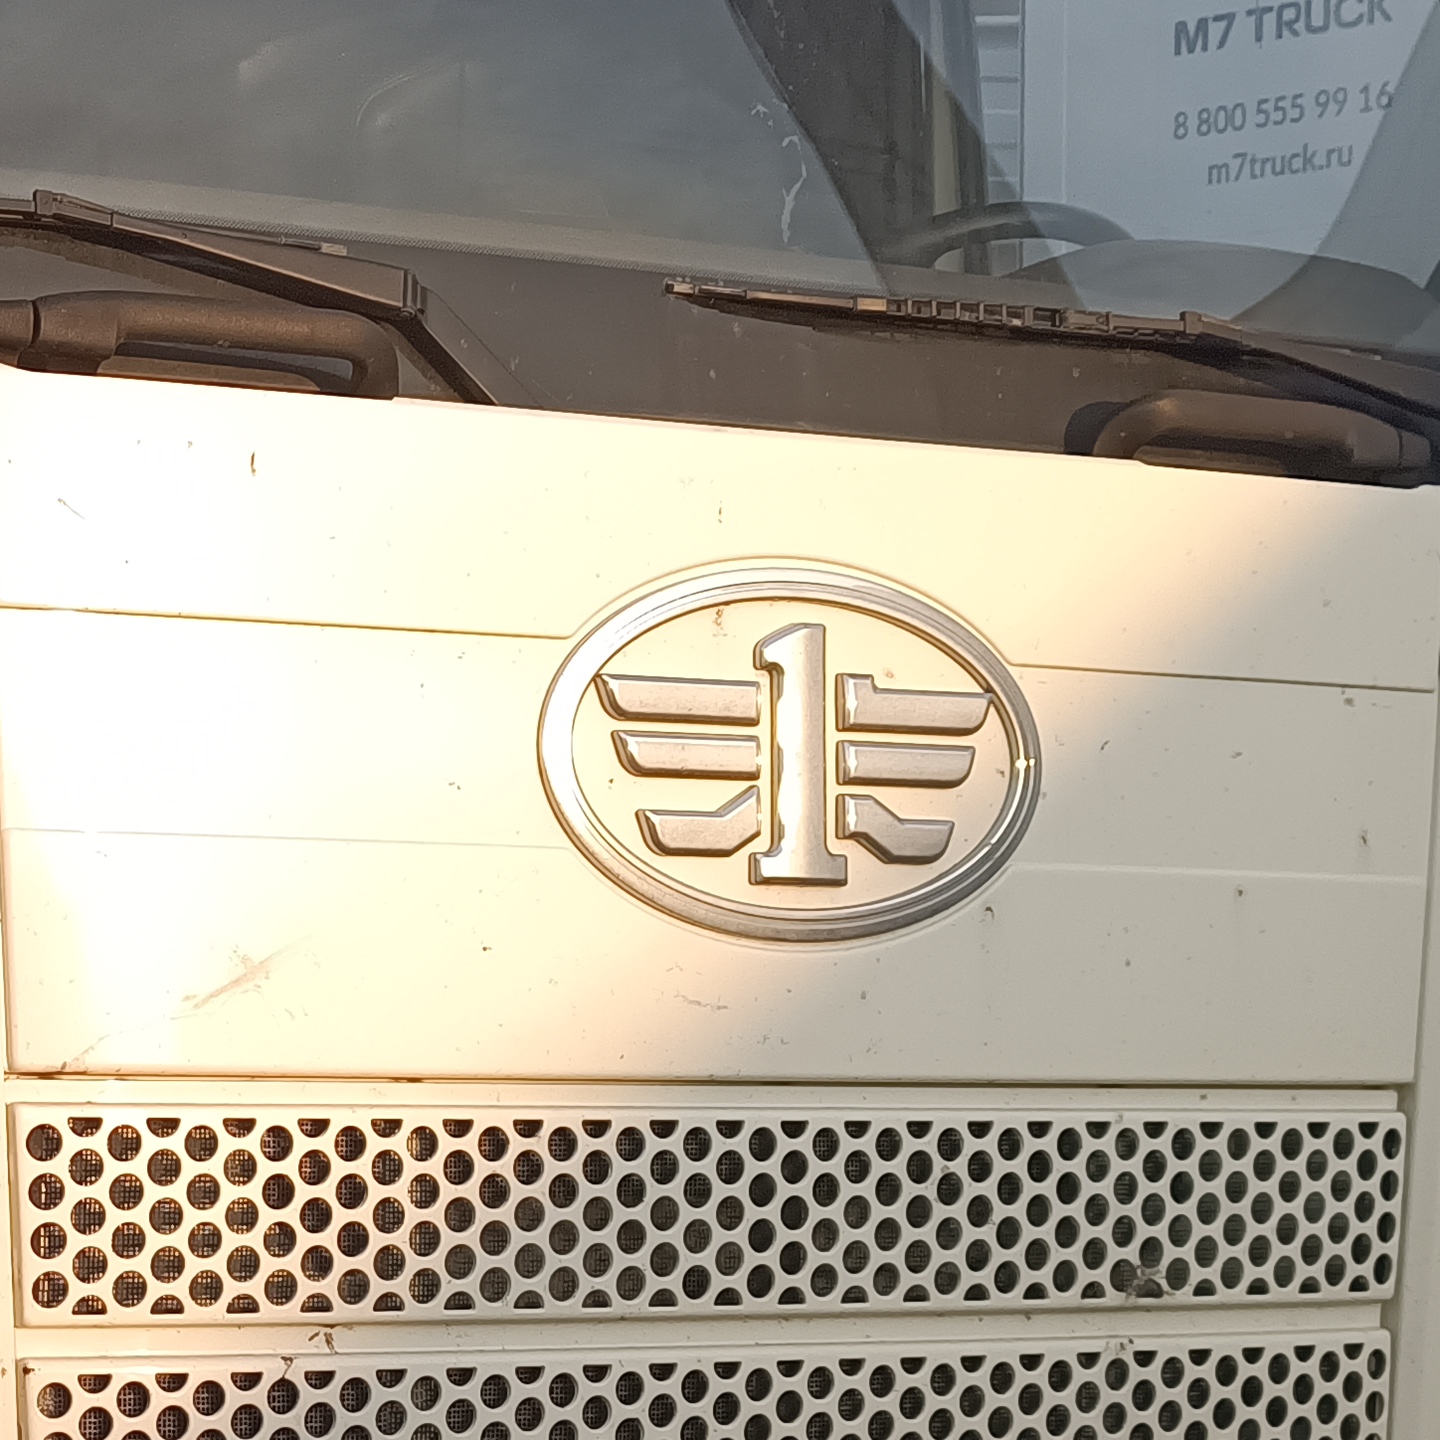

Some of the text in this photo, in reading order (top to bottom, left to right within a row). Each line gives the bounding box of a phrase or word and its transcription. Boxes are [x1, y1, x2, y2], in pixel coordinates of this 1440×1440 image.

[1173, 12, 1236, 56] M7
[1173, 80, 1395, 140] 8 800 555 99 16
[1207, 142, 1354, 186] m7truck.ru
